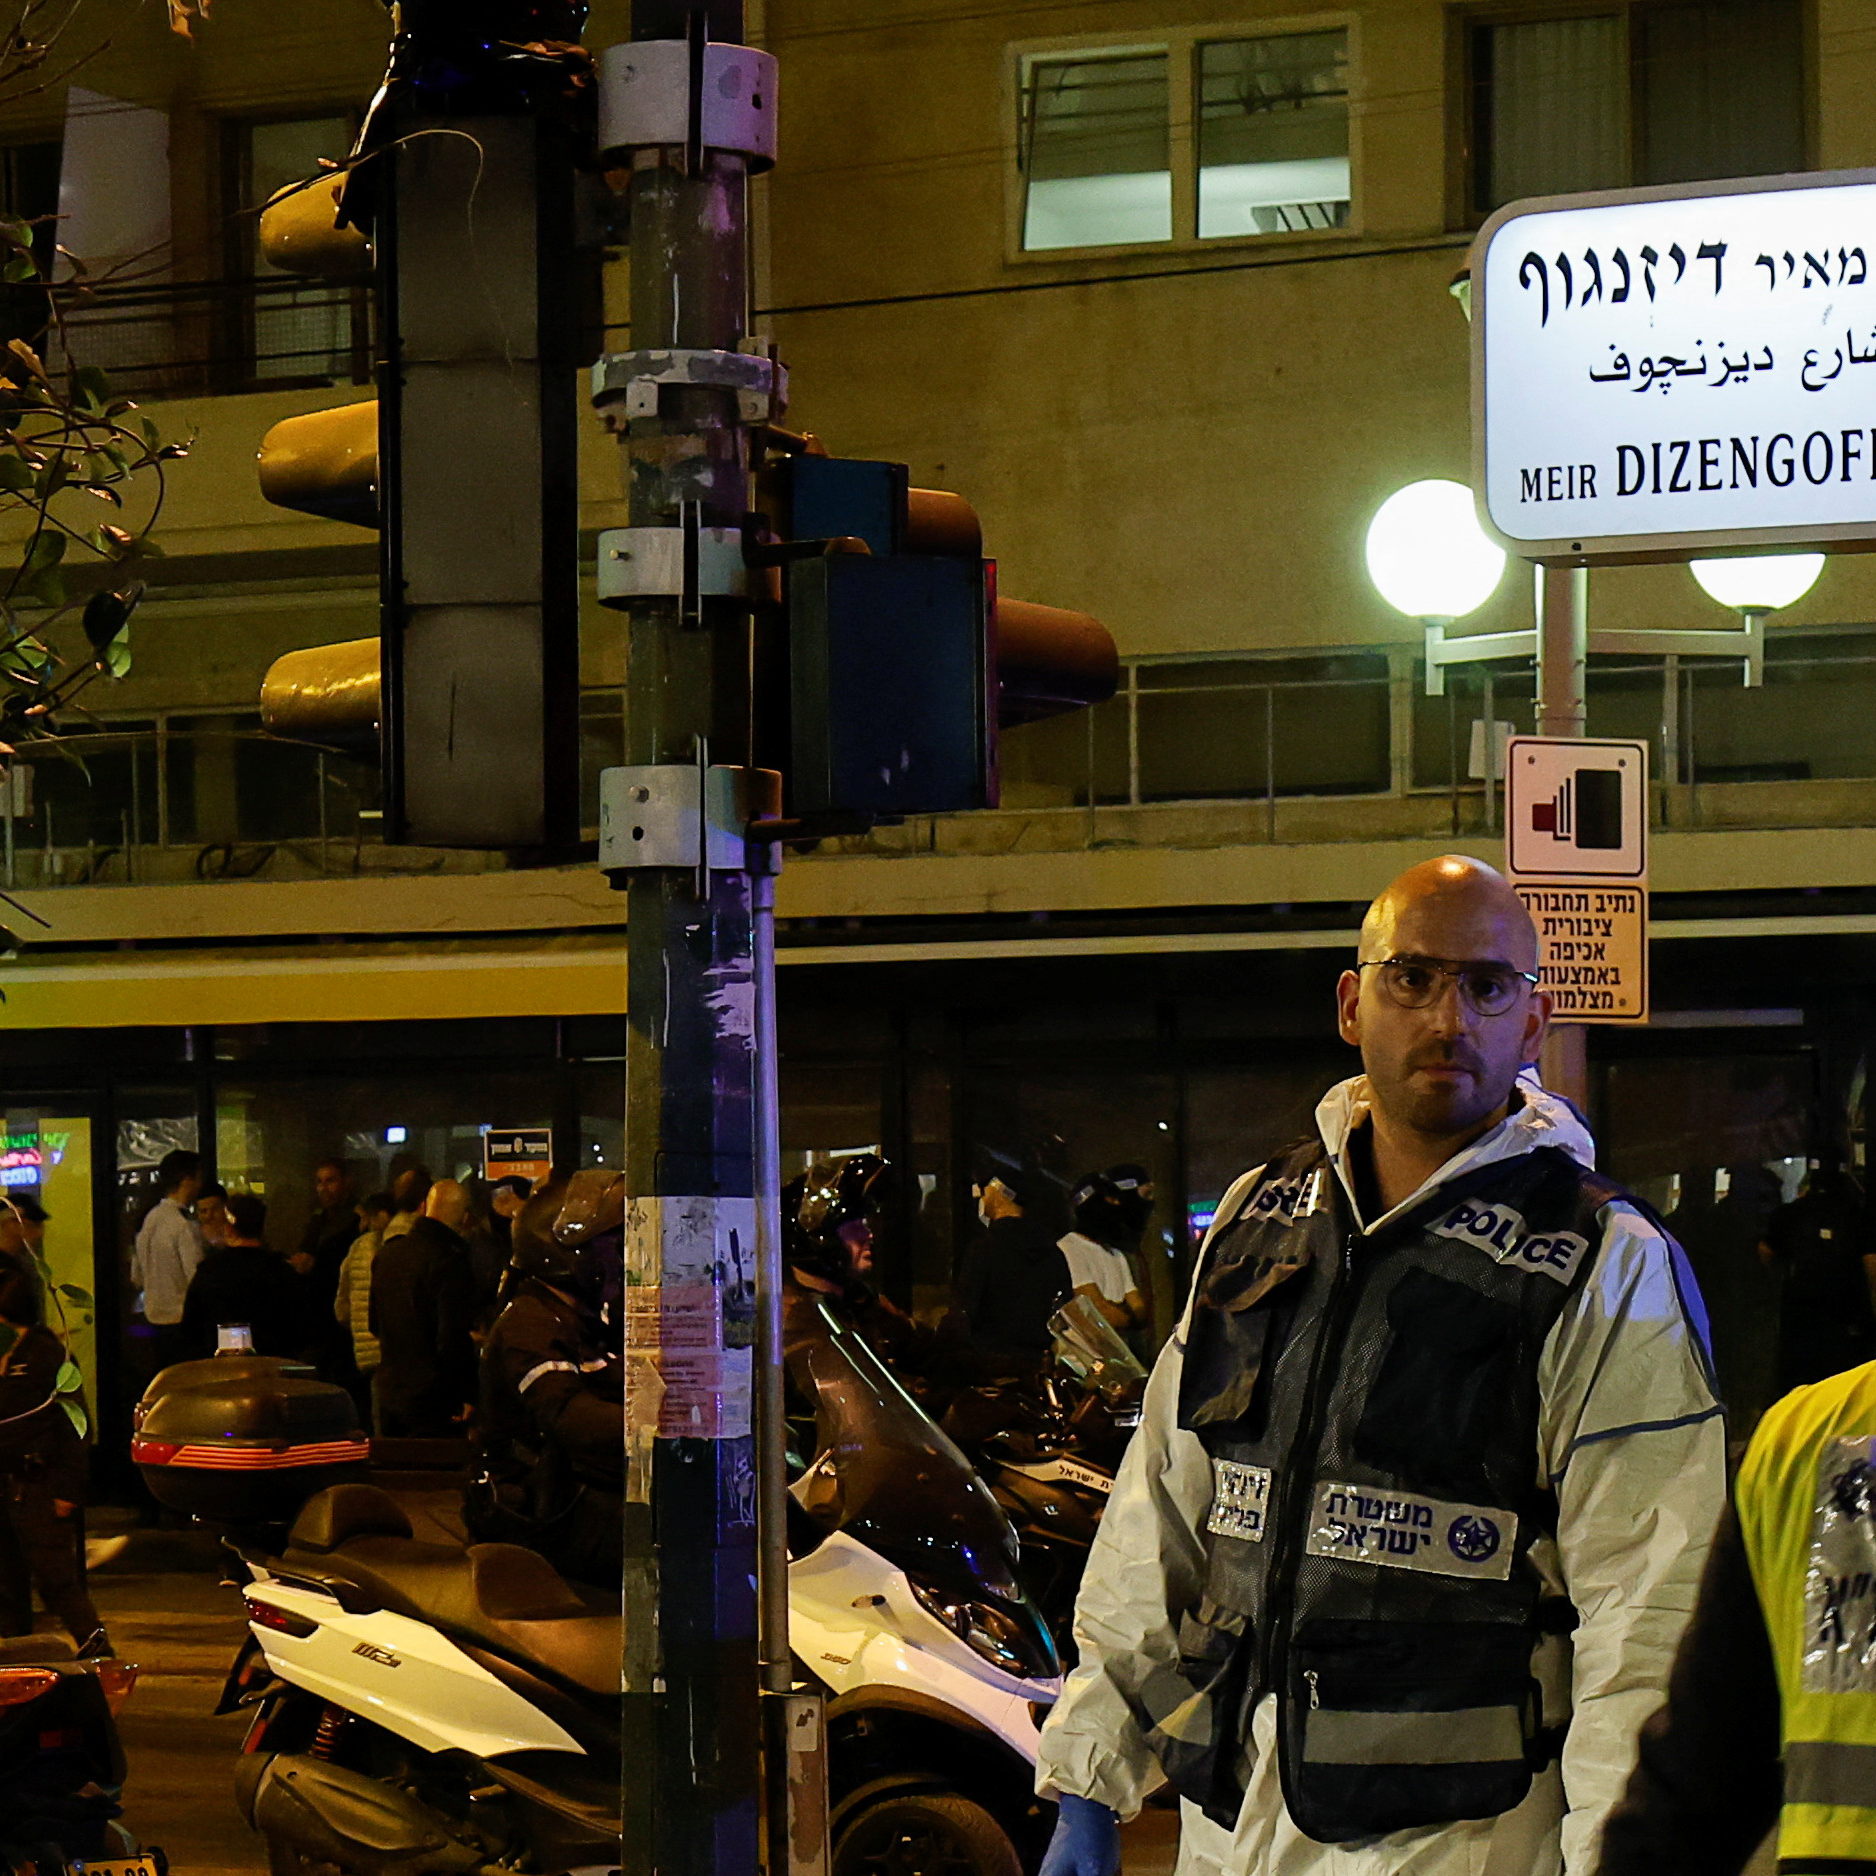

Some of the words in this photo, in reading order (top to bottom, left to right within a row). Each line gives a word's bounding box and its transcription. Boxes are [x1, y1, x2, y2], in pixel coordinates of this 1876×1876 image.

[1518, 238, 1728, 328] דיזנגוף
[1754, 246, 1867, 292] מאיר
[1520, 464, 1597, 503] MEIR
[1596, 894, 1636, 914] נתיב
[1542, 917, 1613, 937] ציבורית
[1549, 941, 1606, 961] אכיפה
[1550, 986, 1614, 1009] מצלמו
[1443, 1203, 1577, 1272] POLICE
[1325, 1491, 1434, 1529] משטרת
[1328, 1516, 1432, 1556] ישראל
